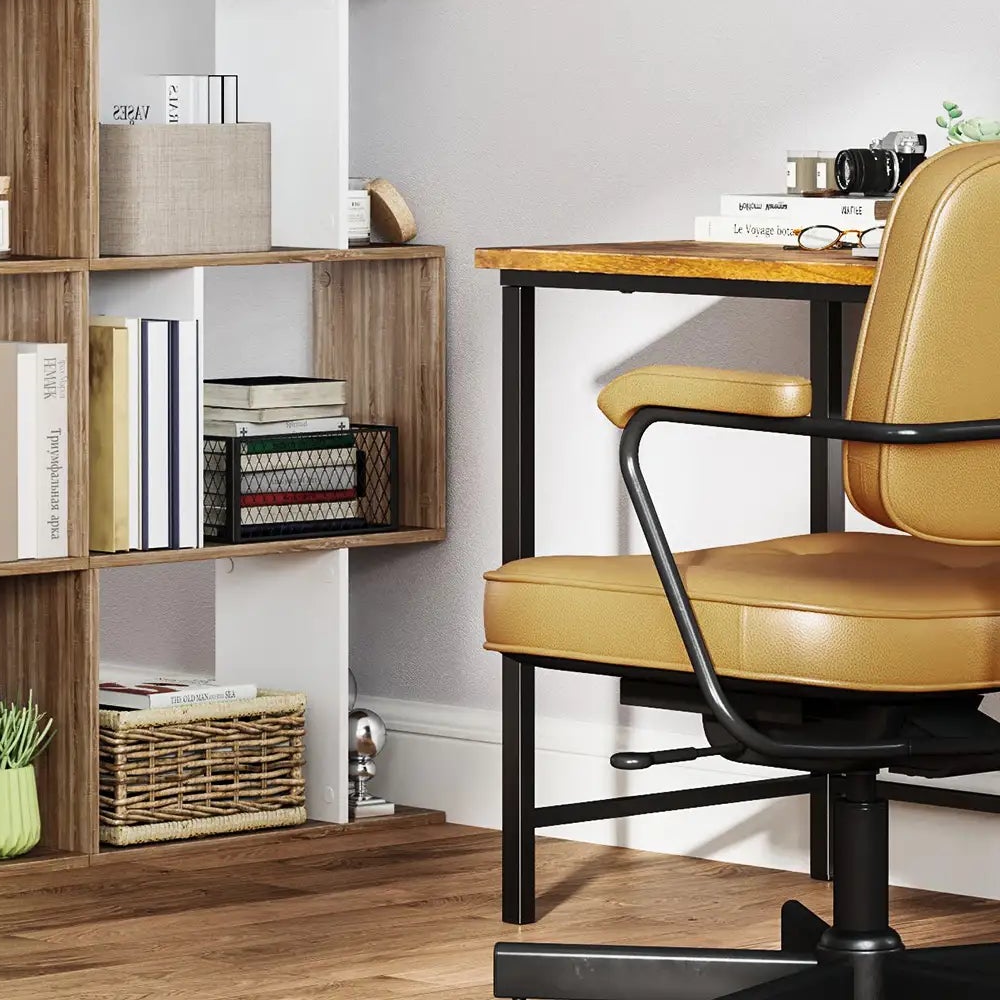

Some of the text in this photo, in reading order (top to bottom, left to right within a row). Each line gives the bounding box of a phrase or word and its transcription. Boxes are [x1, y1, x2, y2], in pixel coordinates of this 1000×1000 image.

[734, 224, 744, 234] Le
[746, 224, 774, 238] Voyage
[47, 428, 63, 540] Триумфальная арка
[183, 694, 196, 703] OLD
[196, 693, 209, 702] MAN
[225, 690, 237, 699] SEA
